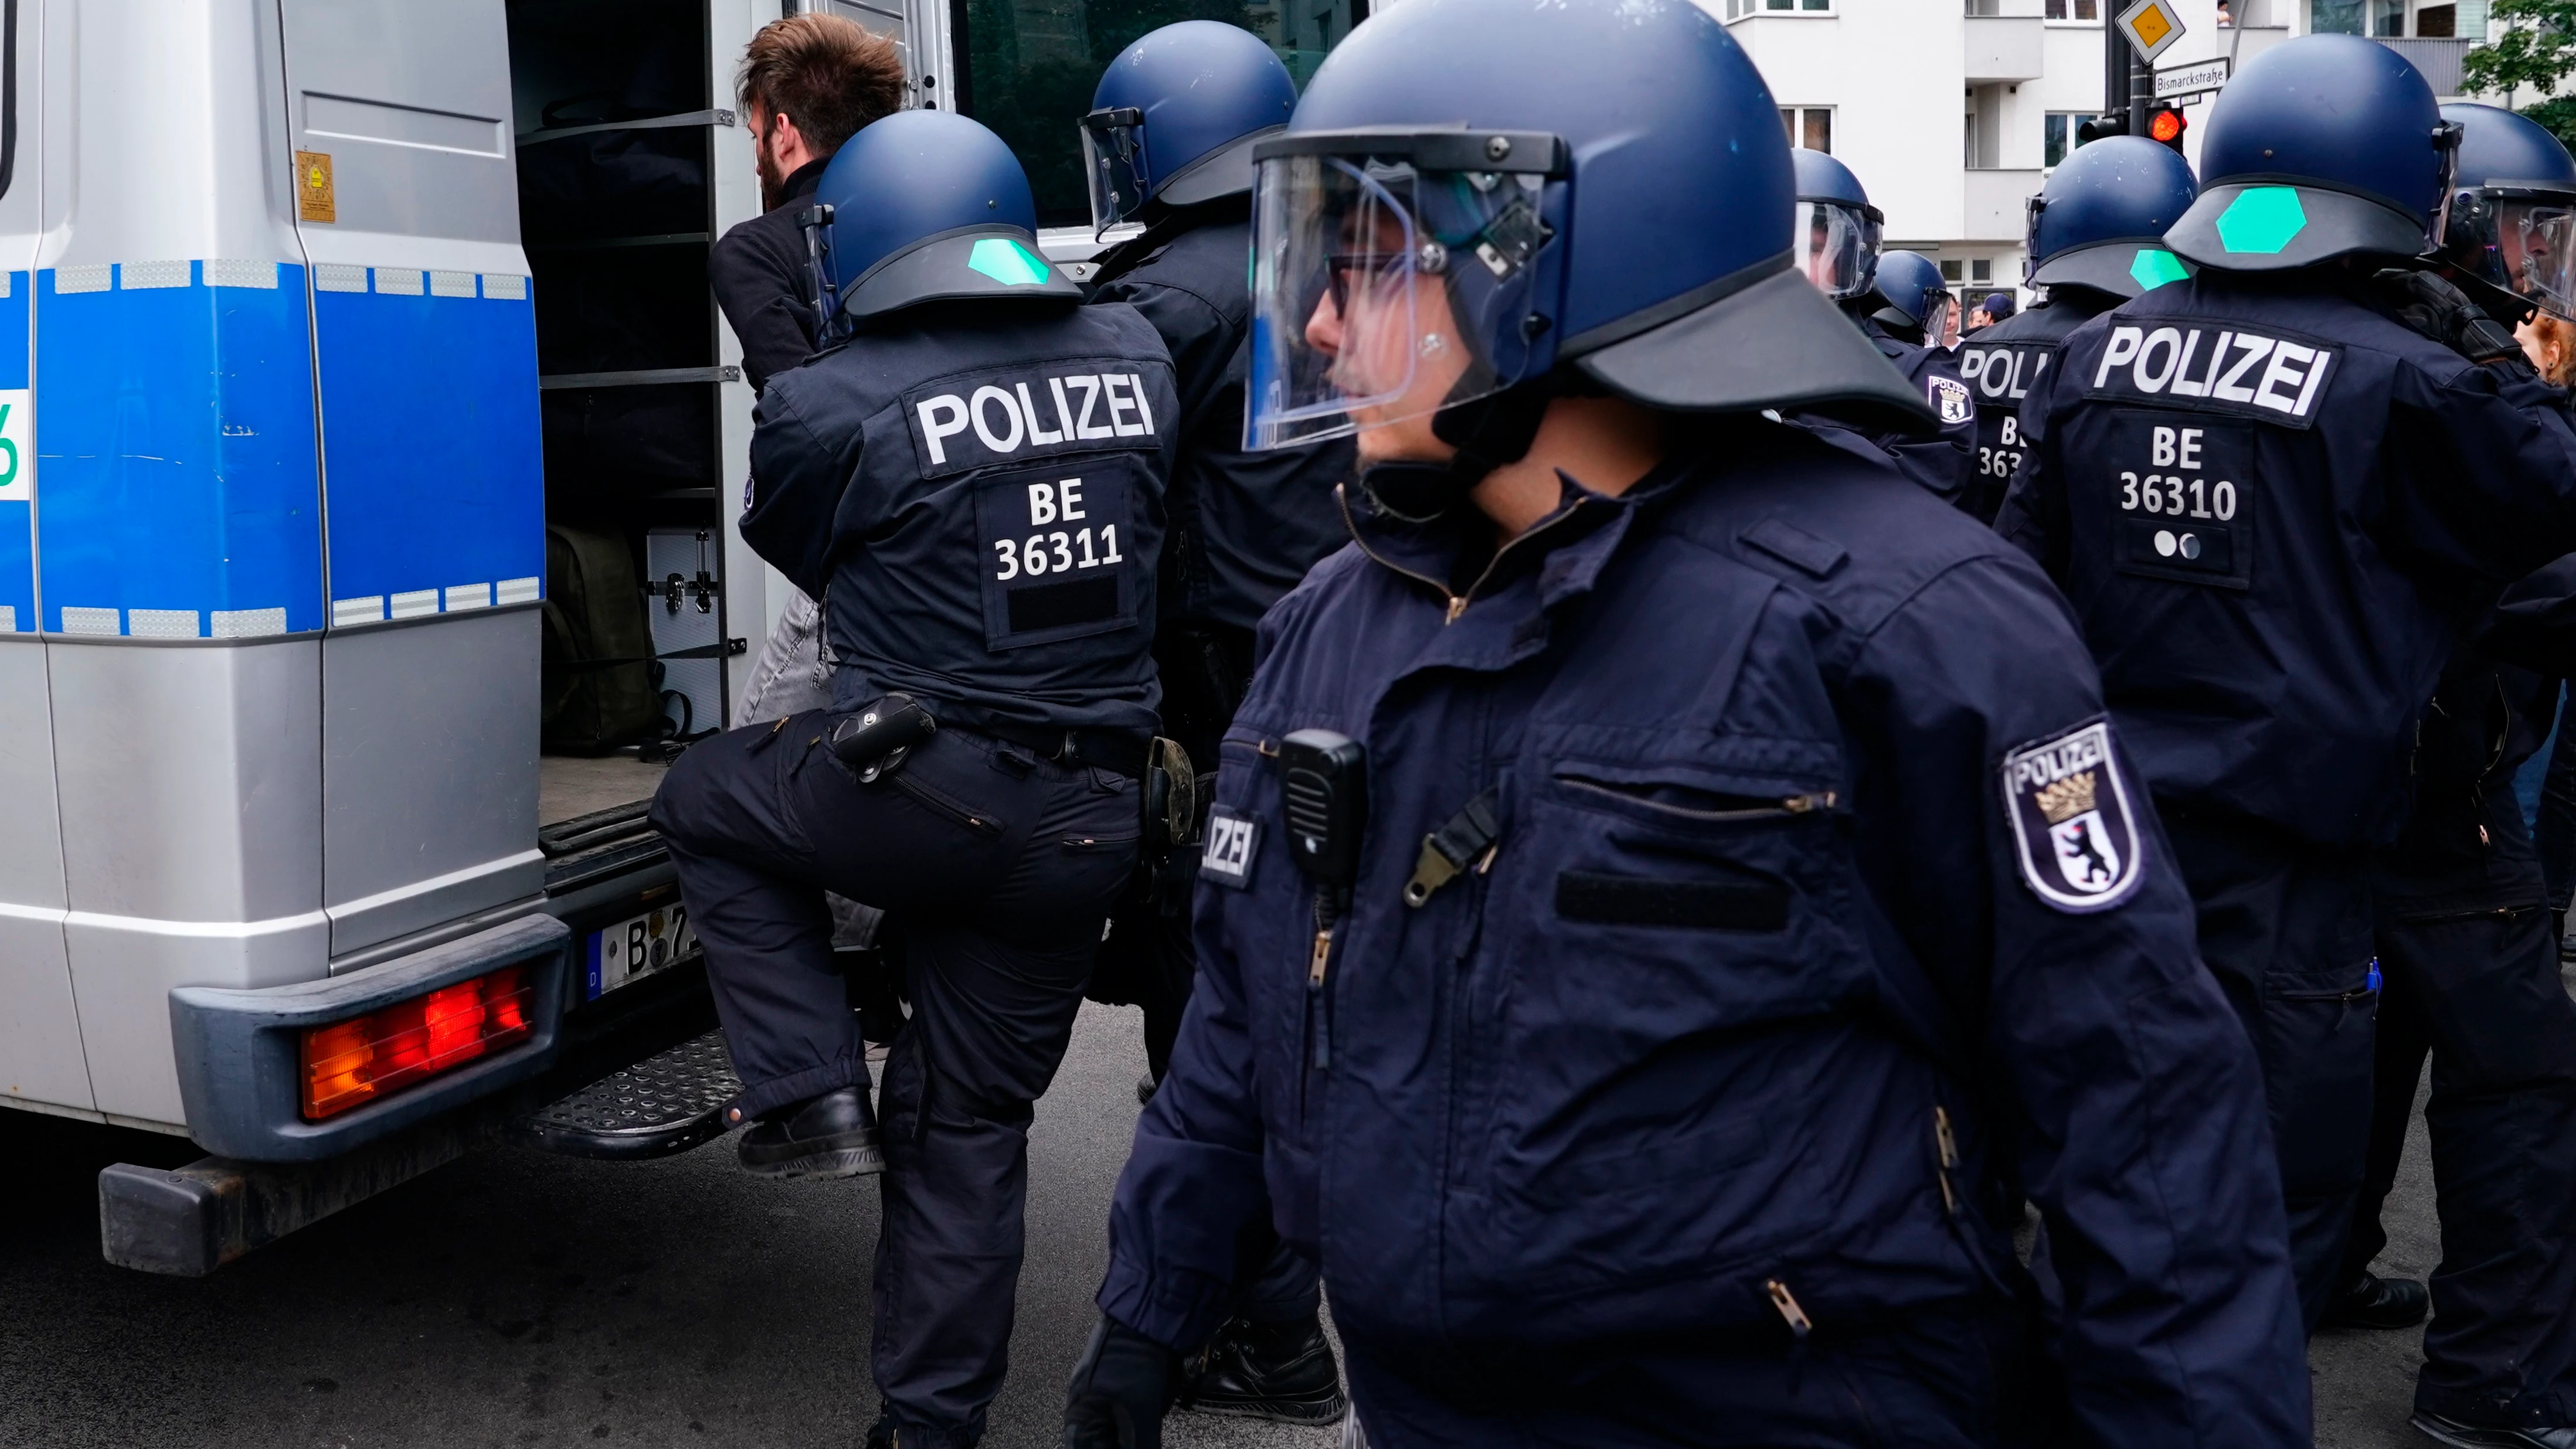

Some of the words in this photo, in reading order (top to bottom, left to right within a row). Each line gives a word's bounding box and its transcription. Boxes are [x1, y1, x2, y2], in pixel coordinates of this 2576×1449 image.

[2157, 68, 2223, 91] Bismarckstraße
[2094, 326, 2331, 416] POLIZEI
[916, 373, 1155, 465] POLIZEI
[2001, 416, 2027, 447] B
[2152, 426, 2203, 470] BE
[1028, 478, 1086, 526] BE
[2120, 471, 2236, 521] 36310
[995, 523, 1123, 581] 36311
[626, 920, 647, 976] B
[590, 971, 596, 987] D
